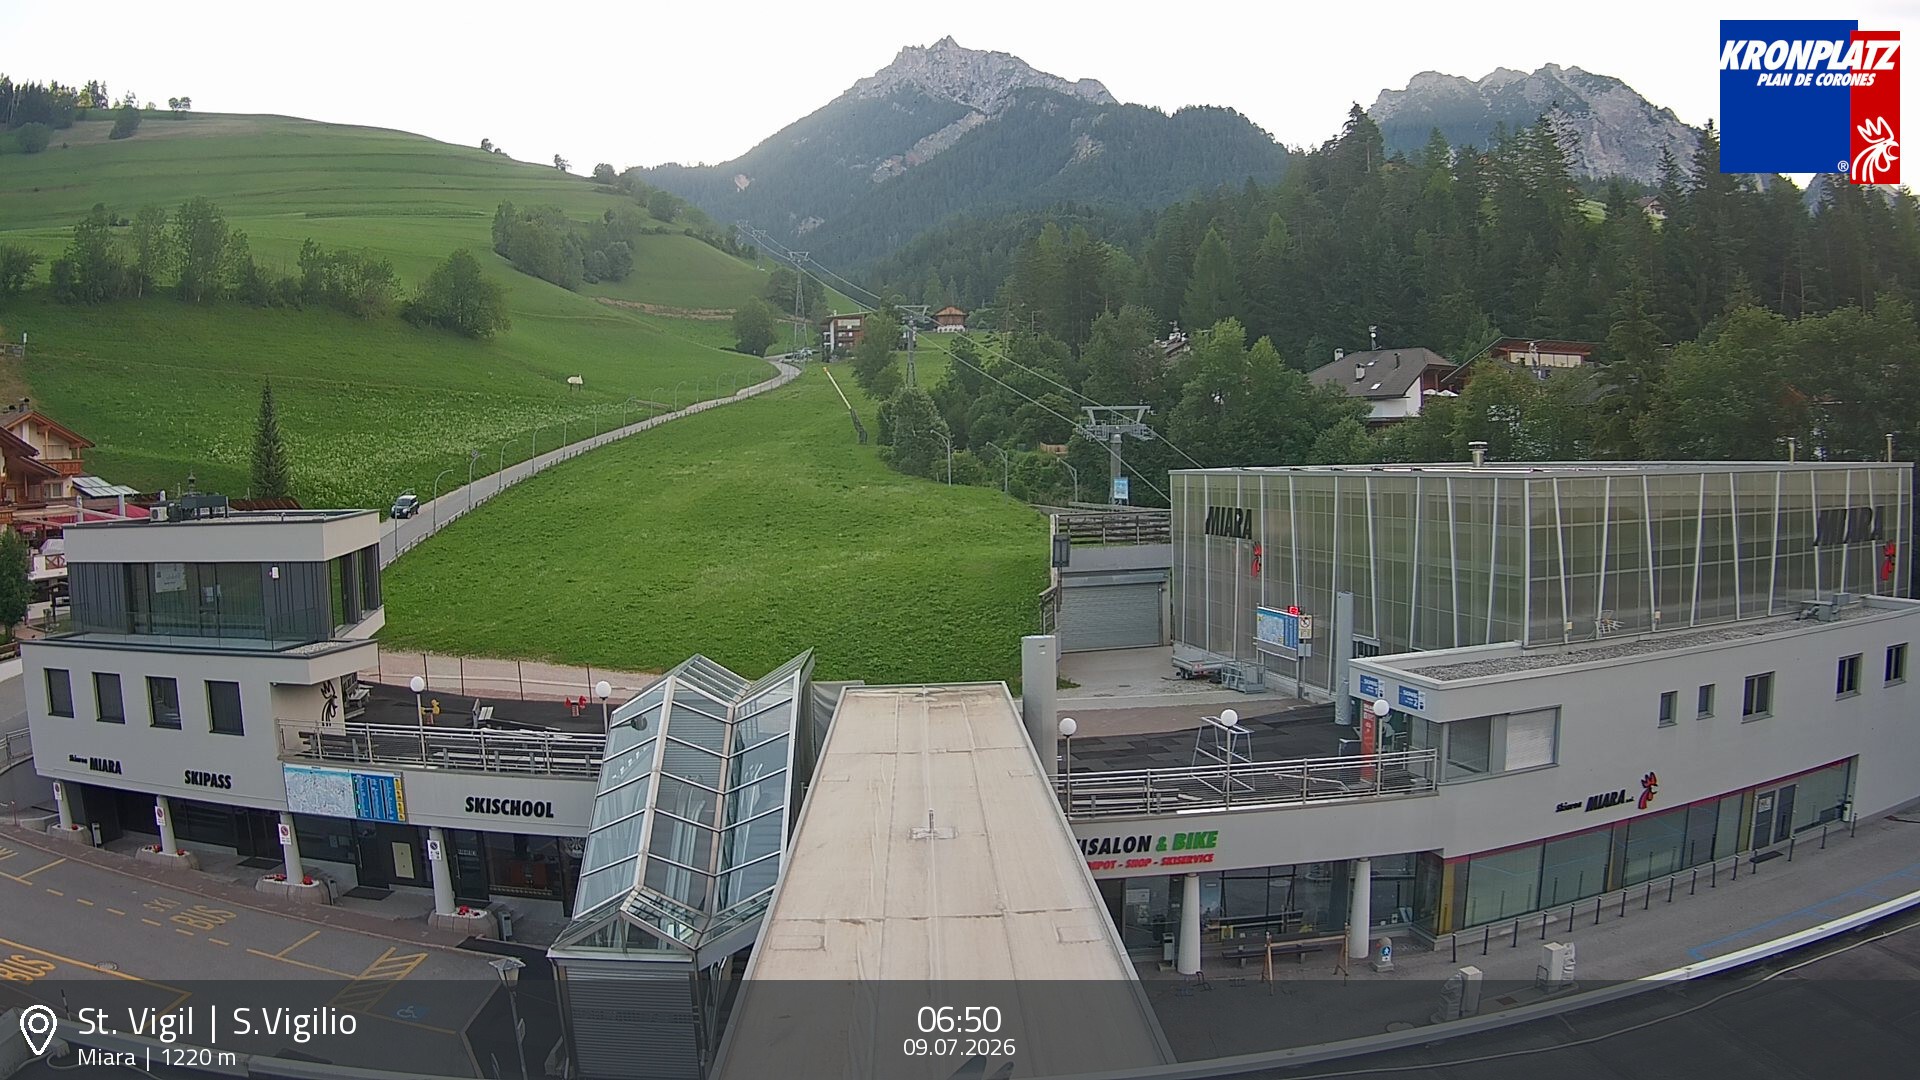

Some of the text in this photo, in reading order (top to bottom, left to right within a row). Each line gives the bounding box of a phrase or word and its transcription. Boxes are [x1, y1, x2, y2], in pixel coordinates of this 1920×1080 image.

[1205, 506, 1252, 540] MIARA
[89, 757, 122, 775] MIARA
[184, 770, 232, 789] SKIPASS
[465, 796, 555, 819] SKISCHOOL
[1585, 789, 1626, 812] MIARA
[1077, 830, 1219, 856] ISALON & BIKE
[1125, 858, 1152, 869] SHOP
[169, 905, 237, 930] BUS
[0, 954, 56, 985] BUS
